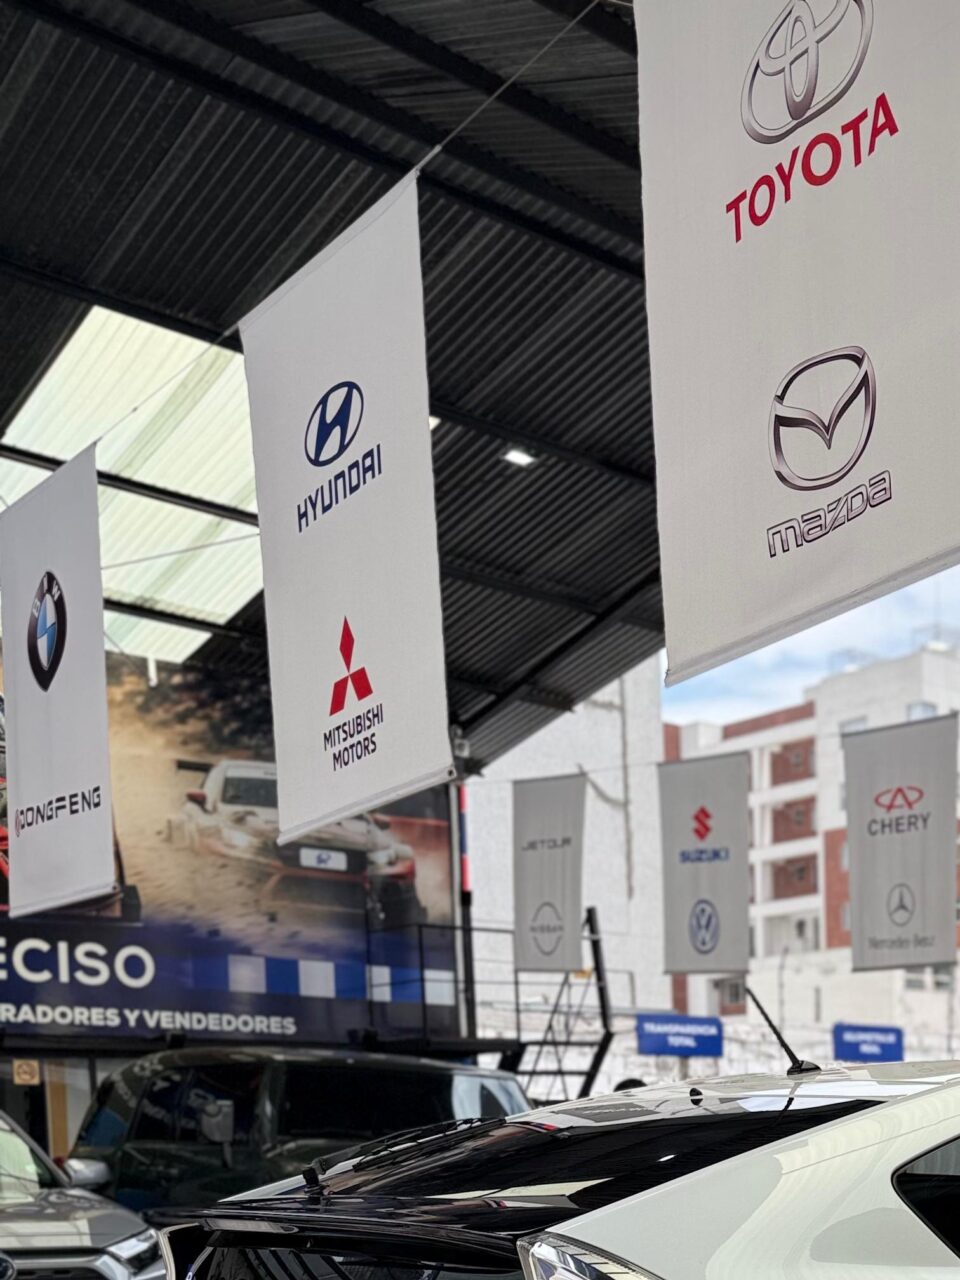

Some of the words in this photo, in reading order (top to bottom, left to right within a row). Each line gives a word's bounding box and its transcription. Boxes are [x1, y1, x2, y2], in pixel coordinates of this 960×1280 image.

[725, 92, 899, 243] TOYOTA
[296, 443, 382, 533] HYUNDAI
[323, 703, 384, 751] MITSUBISHI
[332, 732, 377, 771] MOTORS
[867, 812, 931, 837] CHERY
[679, 848, 730, 863] SUZUKI
[0, 937, 156, 989] CISO
[123, 1010, 143, 1027] Y
[143, 1010, 297, 1035] VENDEDORES
